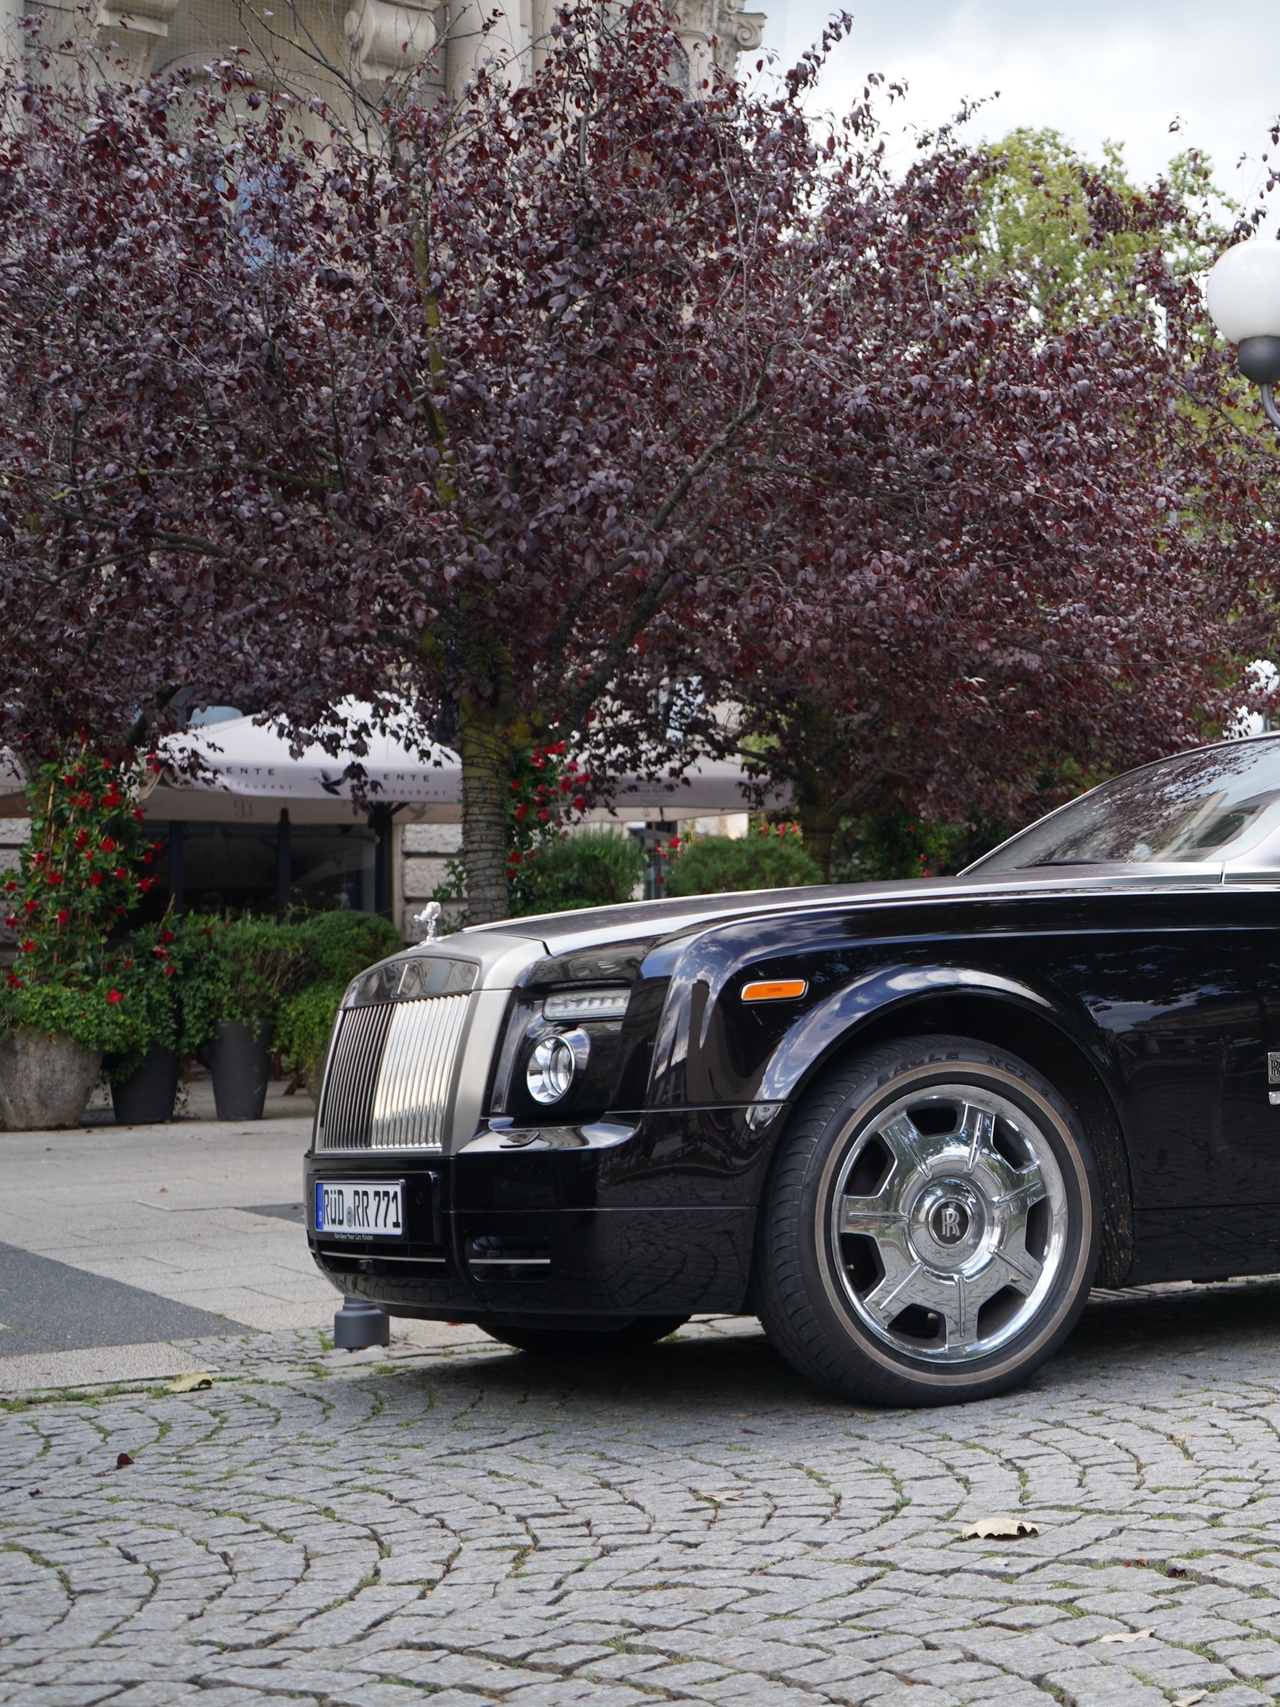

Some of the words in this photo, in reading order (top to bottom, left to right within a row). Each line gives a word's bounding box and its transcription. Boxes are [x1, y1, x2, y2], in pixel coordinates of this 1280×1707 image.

[226, 766, 276, 776] ENTE
[383, 773, 430, 783] ENTE
[323, 1189, 345, 1226] RÜD
[353, 1190, 370, 1228] RR
[373, 1190, 401, 1228] 771
